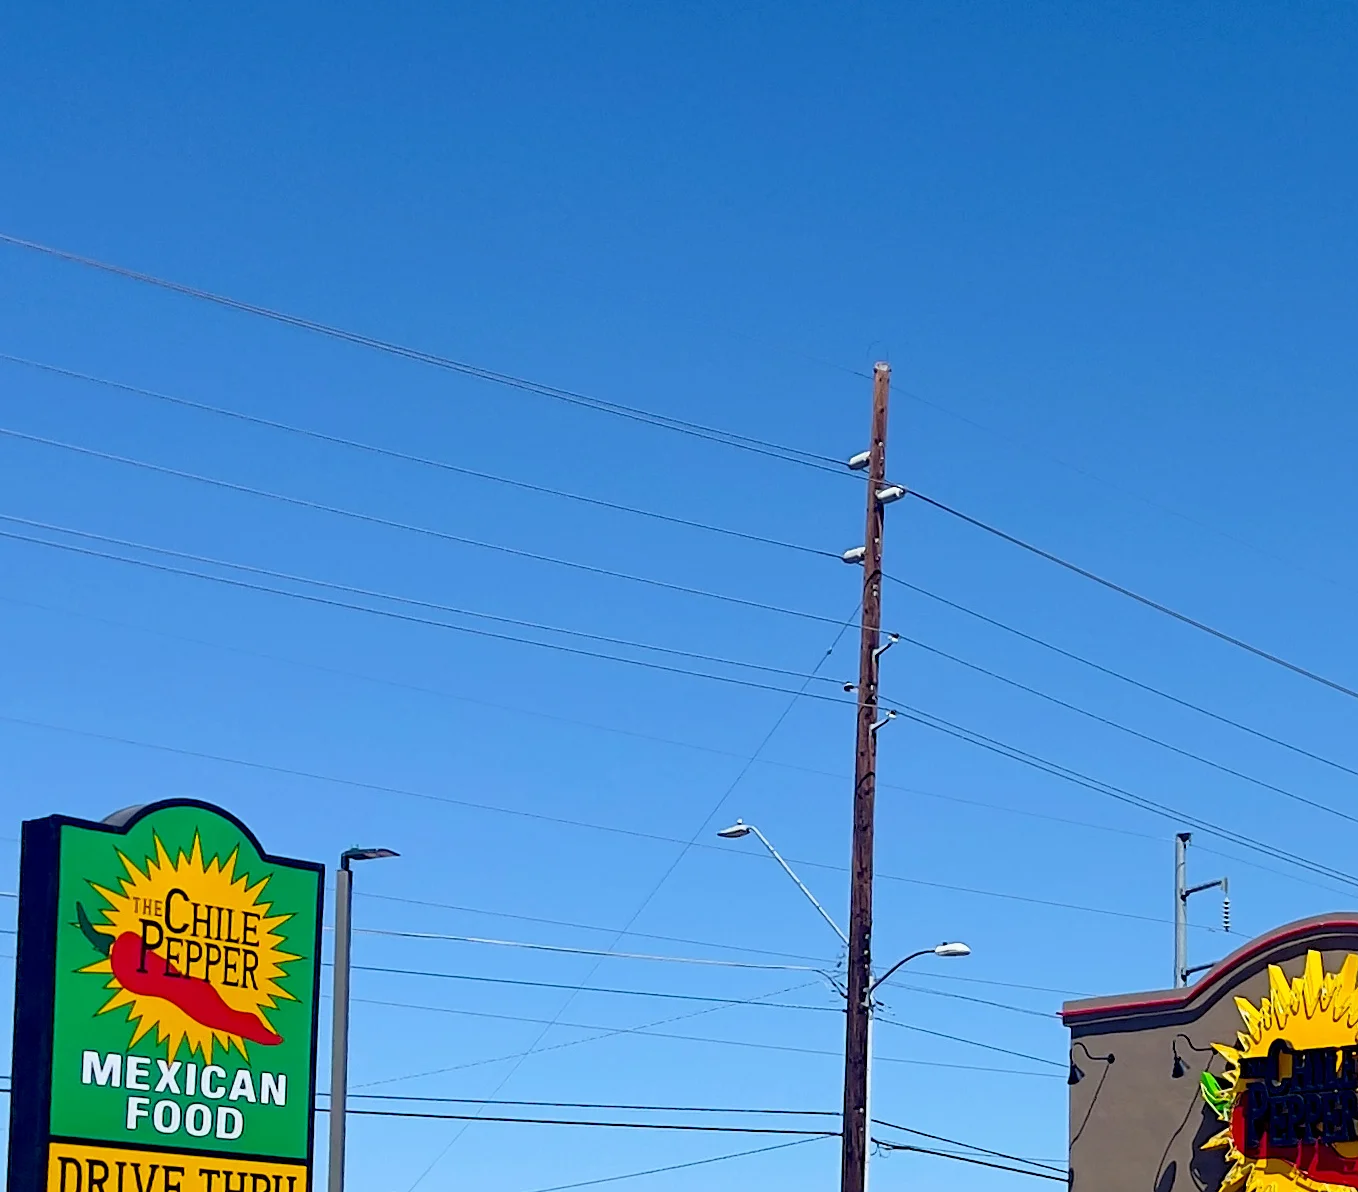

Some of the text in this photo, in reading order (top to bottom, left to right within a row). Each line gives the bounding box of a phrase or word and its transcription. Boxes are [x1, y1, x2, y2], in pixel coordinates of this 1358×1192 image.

[133, 888, 261, 947] THE CHILE
[135, 918, 259, 991] PEPPER
[81, 1050, 288, 1107] MEXICAN
[126, 1096, 245, 1140] FOOD
